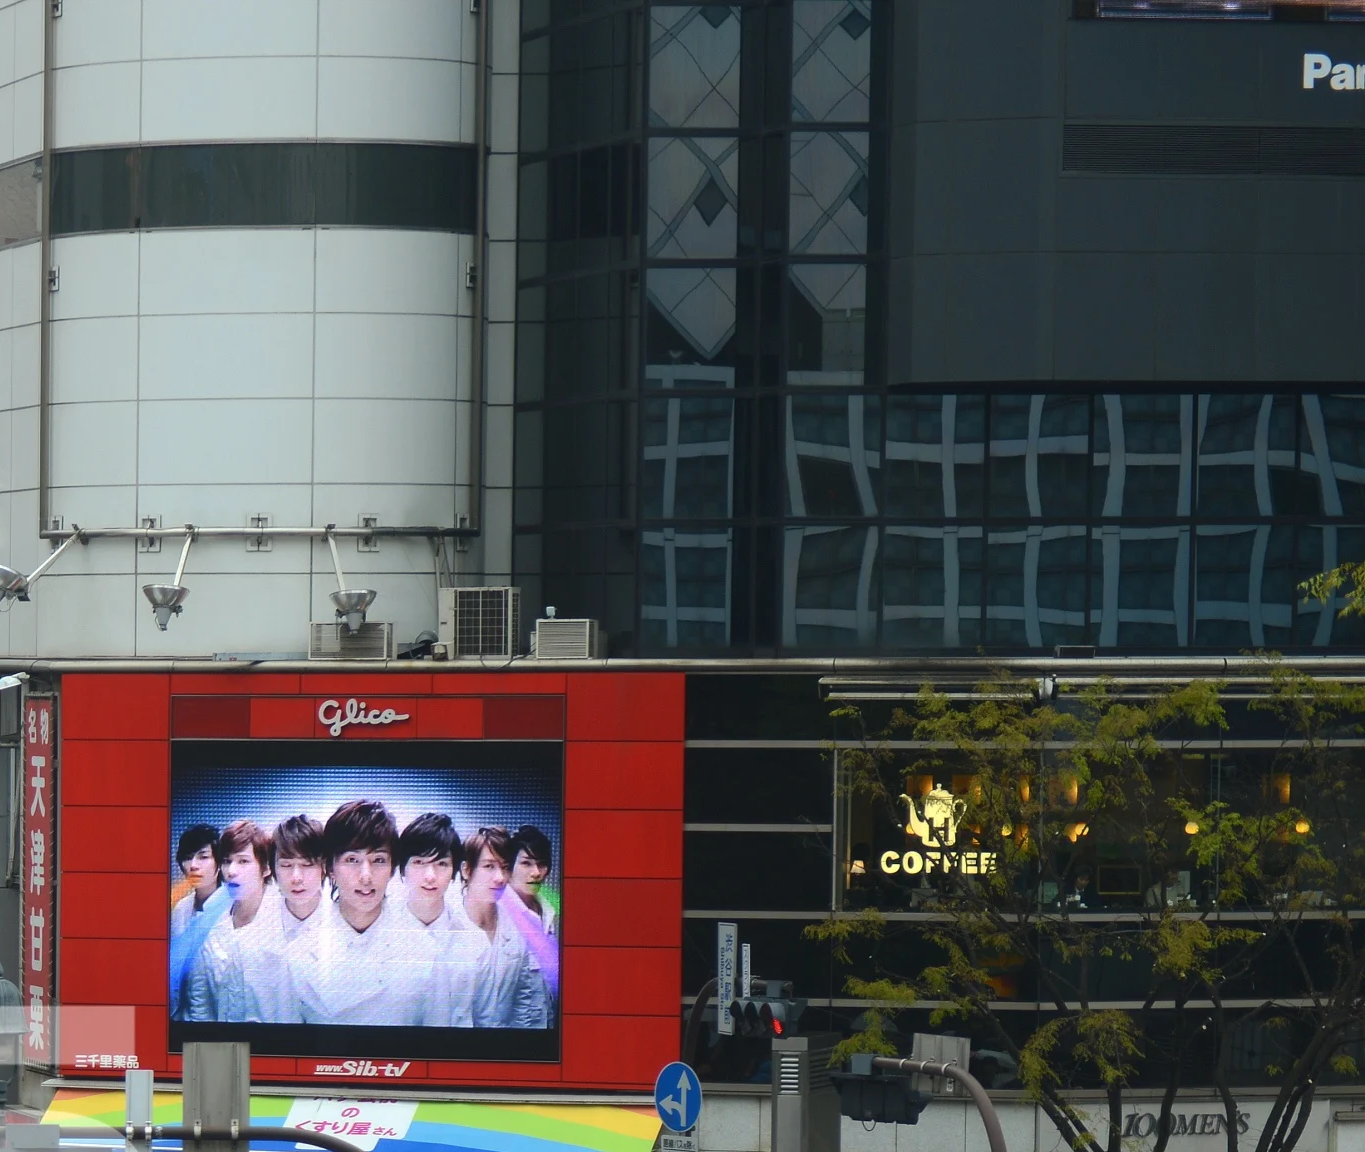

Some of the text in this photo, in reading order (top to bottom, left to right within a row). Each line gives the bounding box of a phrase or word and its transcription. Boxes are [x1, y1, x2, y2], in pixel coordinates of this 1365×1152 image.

[26, 707, 49, 746] 名物
[318, 699, 410, 736] Glico
[880, 850, 997, 875] COFFEE
[24, 754, 49, 1051] 天津甘栗
[75, 1054, 140, 1069] 三千里薬品
[340, 1107, 362, 1120] の
